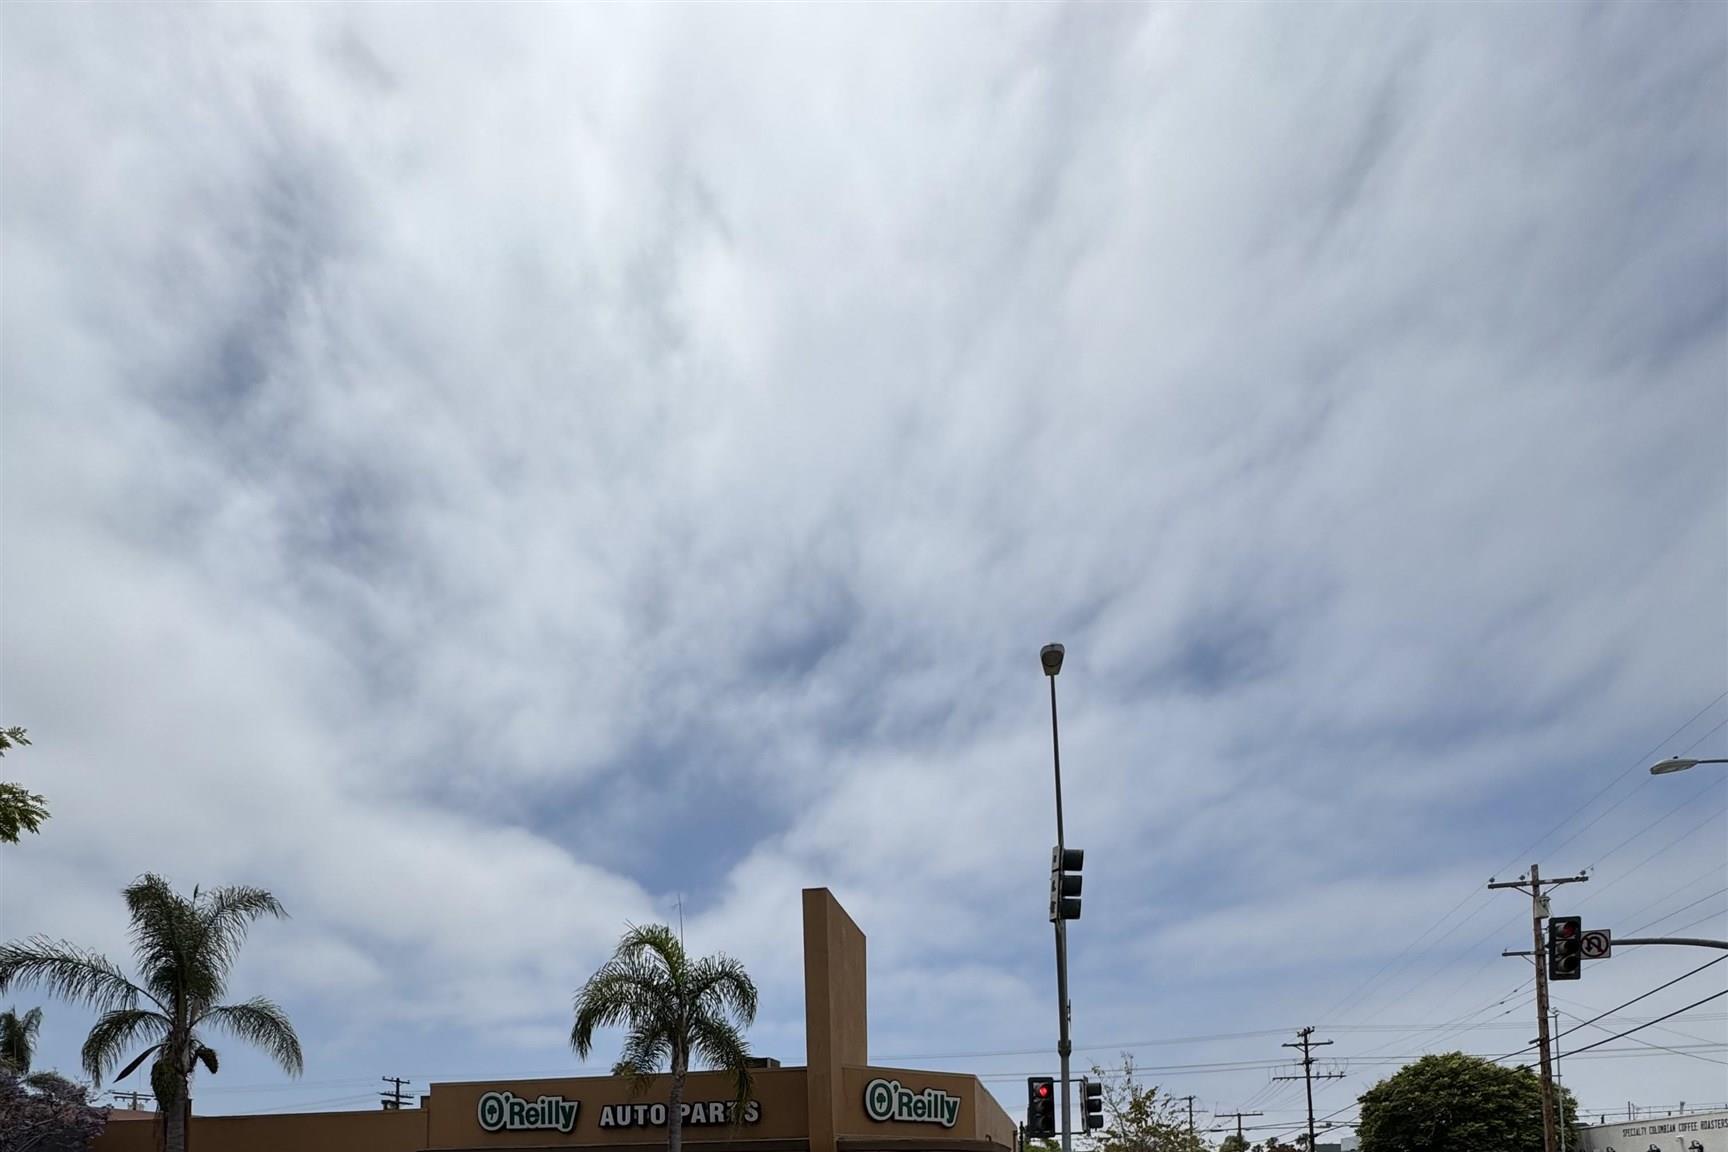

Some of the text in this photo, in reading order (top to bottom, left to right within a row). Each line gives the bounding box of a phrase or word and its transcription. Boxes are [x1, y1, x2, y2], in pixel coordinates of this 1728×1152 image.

[479, 1092, 577, 1131] O'Reilly
[600, 1103, 666, 1126] AUTO
[867, 1081, 959, 1126] O'Reilly
[1622, 1127, 1647, 1138] SPECIALTY
[1678, 1121, 1698, 1133] COFFEE
[1700, 1119, 1728, 1130] ROASTERS
